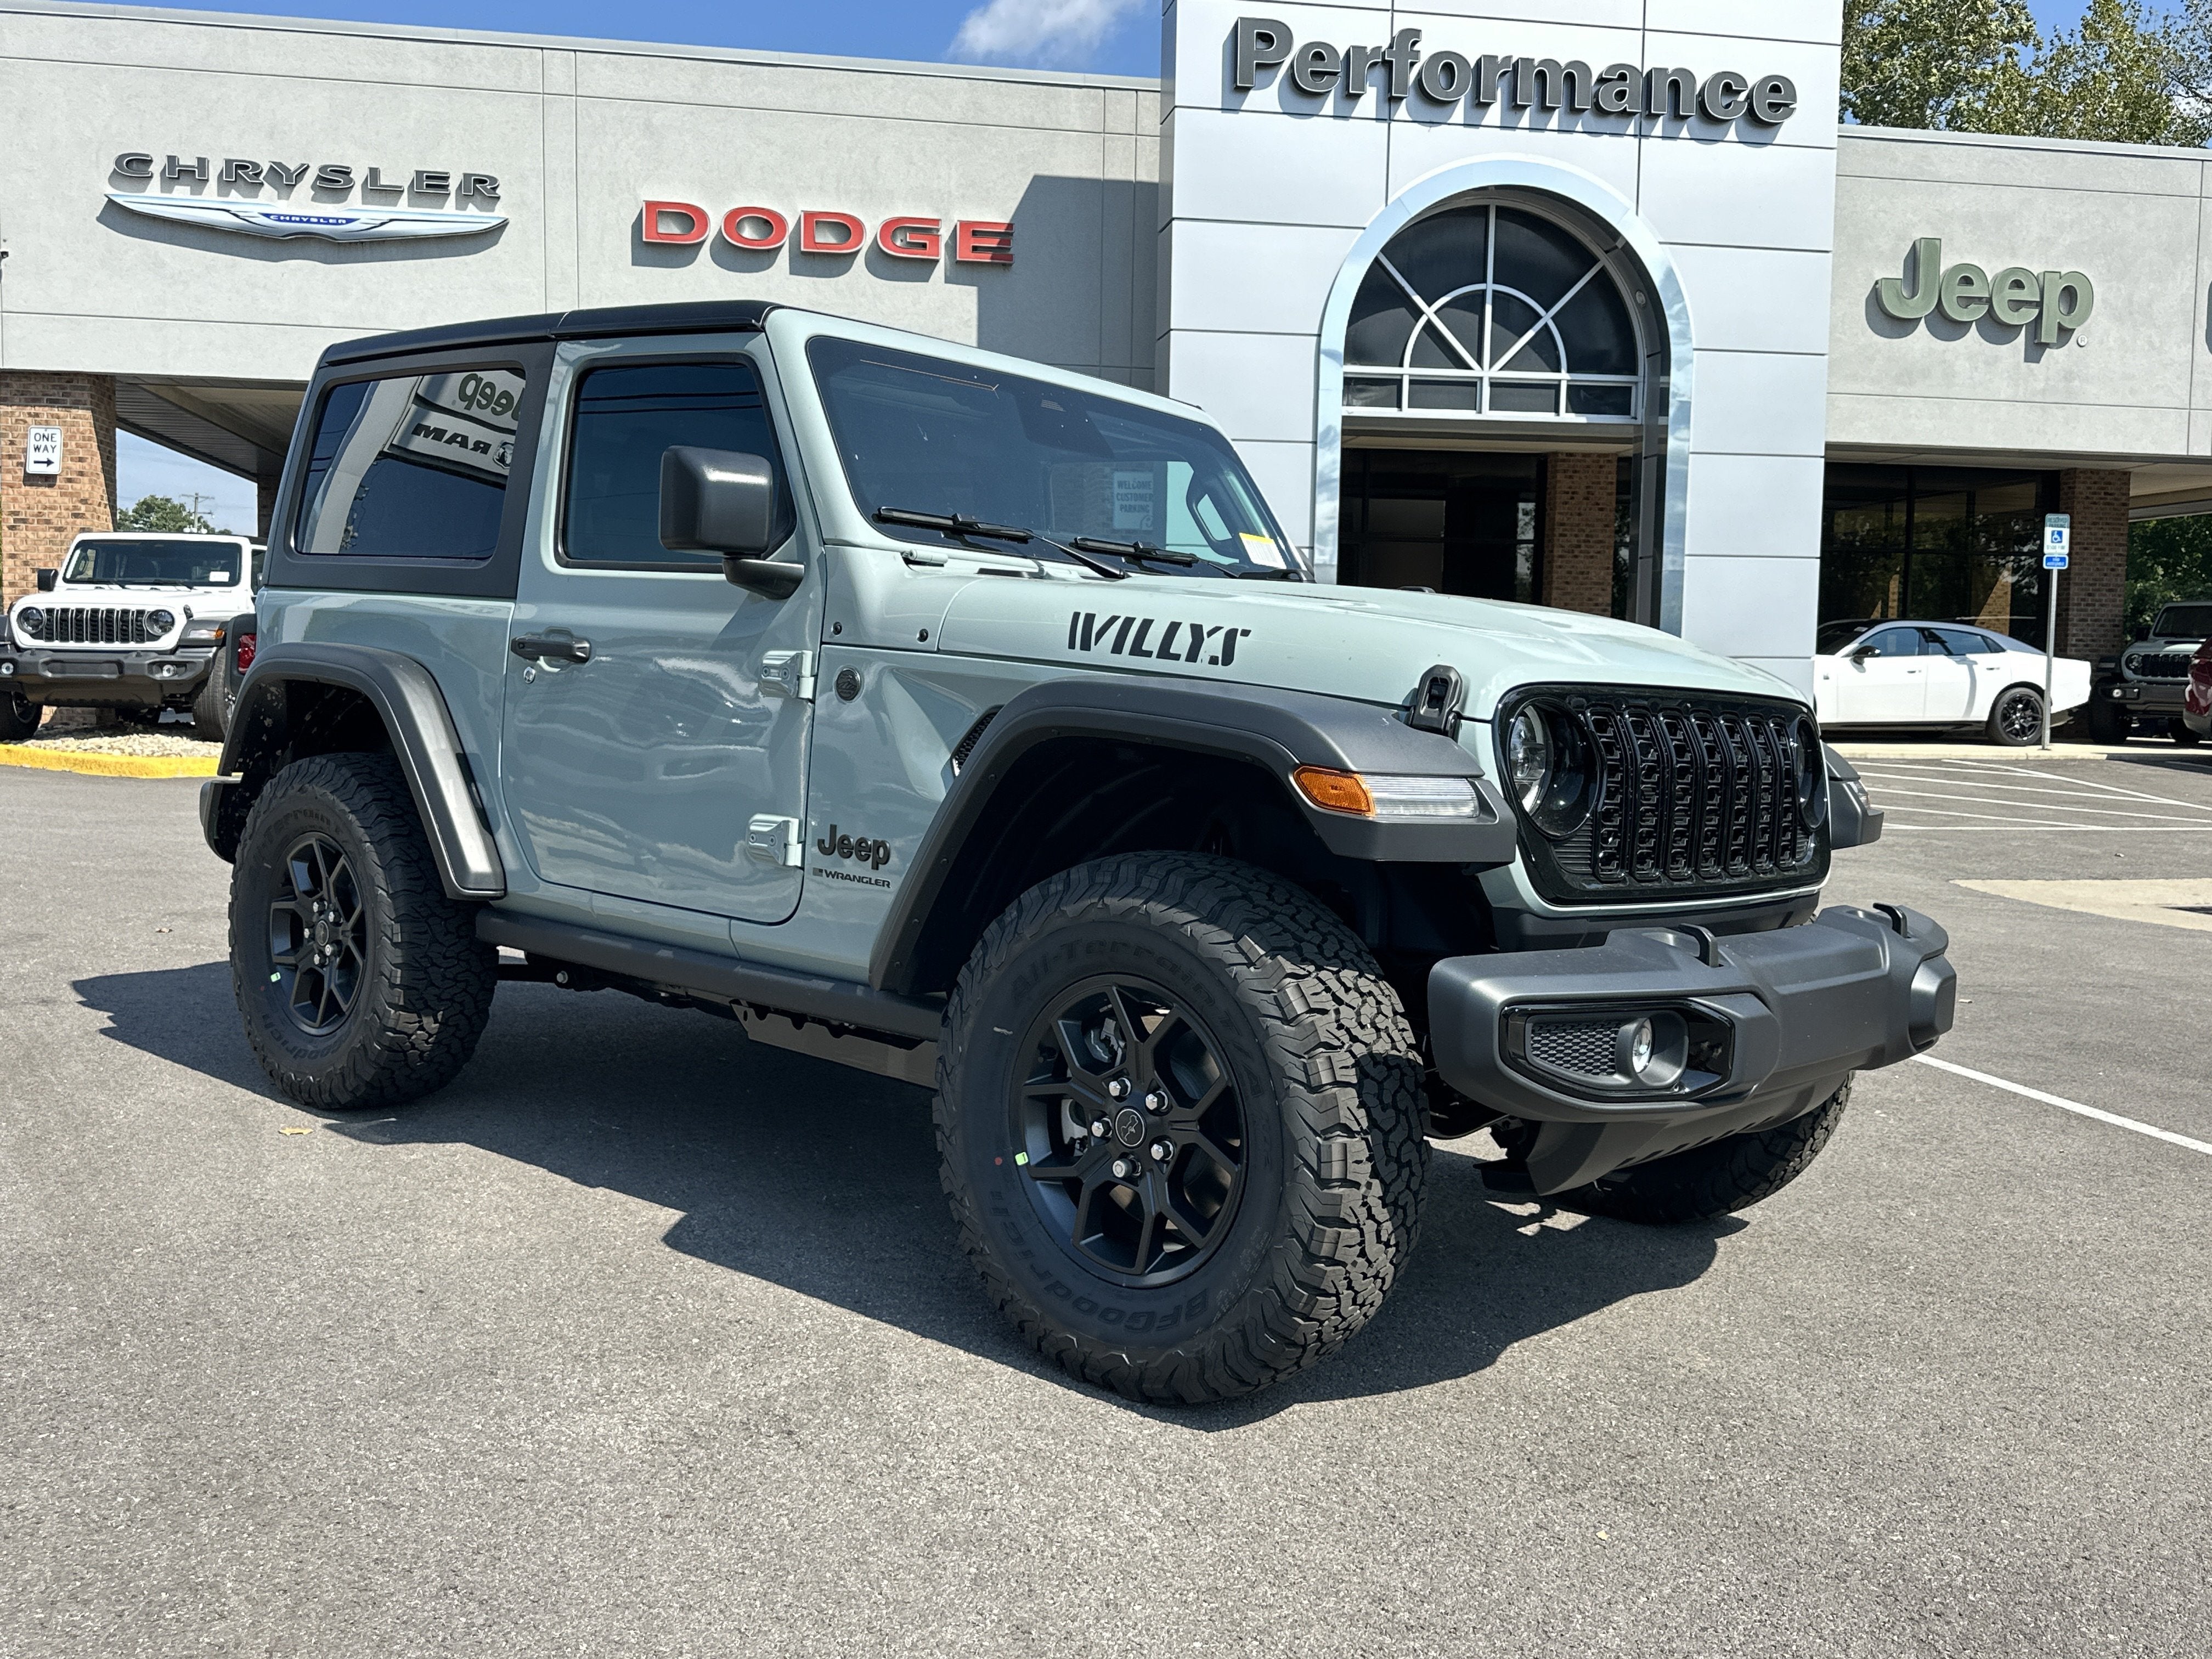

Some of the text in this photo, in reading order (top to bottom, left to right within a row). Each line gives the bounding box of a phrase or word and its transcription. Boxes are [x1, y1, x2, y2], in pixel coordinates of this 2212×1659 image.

[1234, 16, 1798, 126] Performance
[114, 152, 500, 198] CHRYSLER
[269, 215, 347, 224] CHRYSLER
[642, 200, 1015, 266] DODGE
[1875, 238, 2094, 343] Jeep
[33, 444, 57, 453] WAY
[34, 432, 57, 442] ONE
[1117, 480, 1152, 490] WELCOME
[1120, 504, 1150, 513] PARKING
[1068, 611, 1251, 666] WILLYS
[817, 823, 891, 870] Jeep
[824, 869, 891, 889] WRANGLER
[989, 1190, 1208, 1333] BFGoodrich
